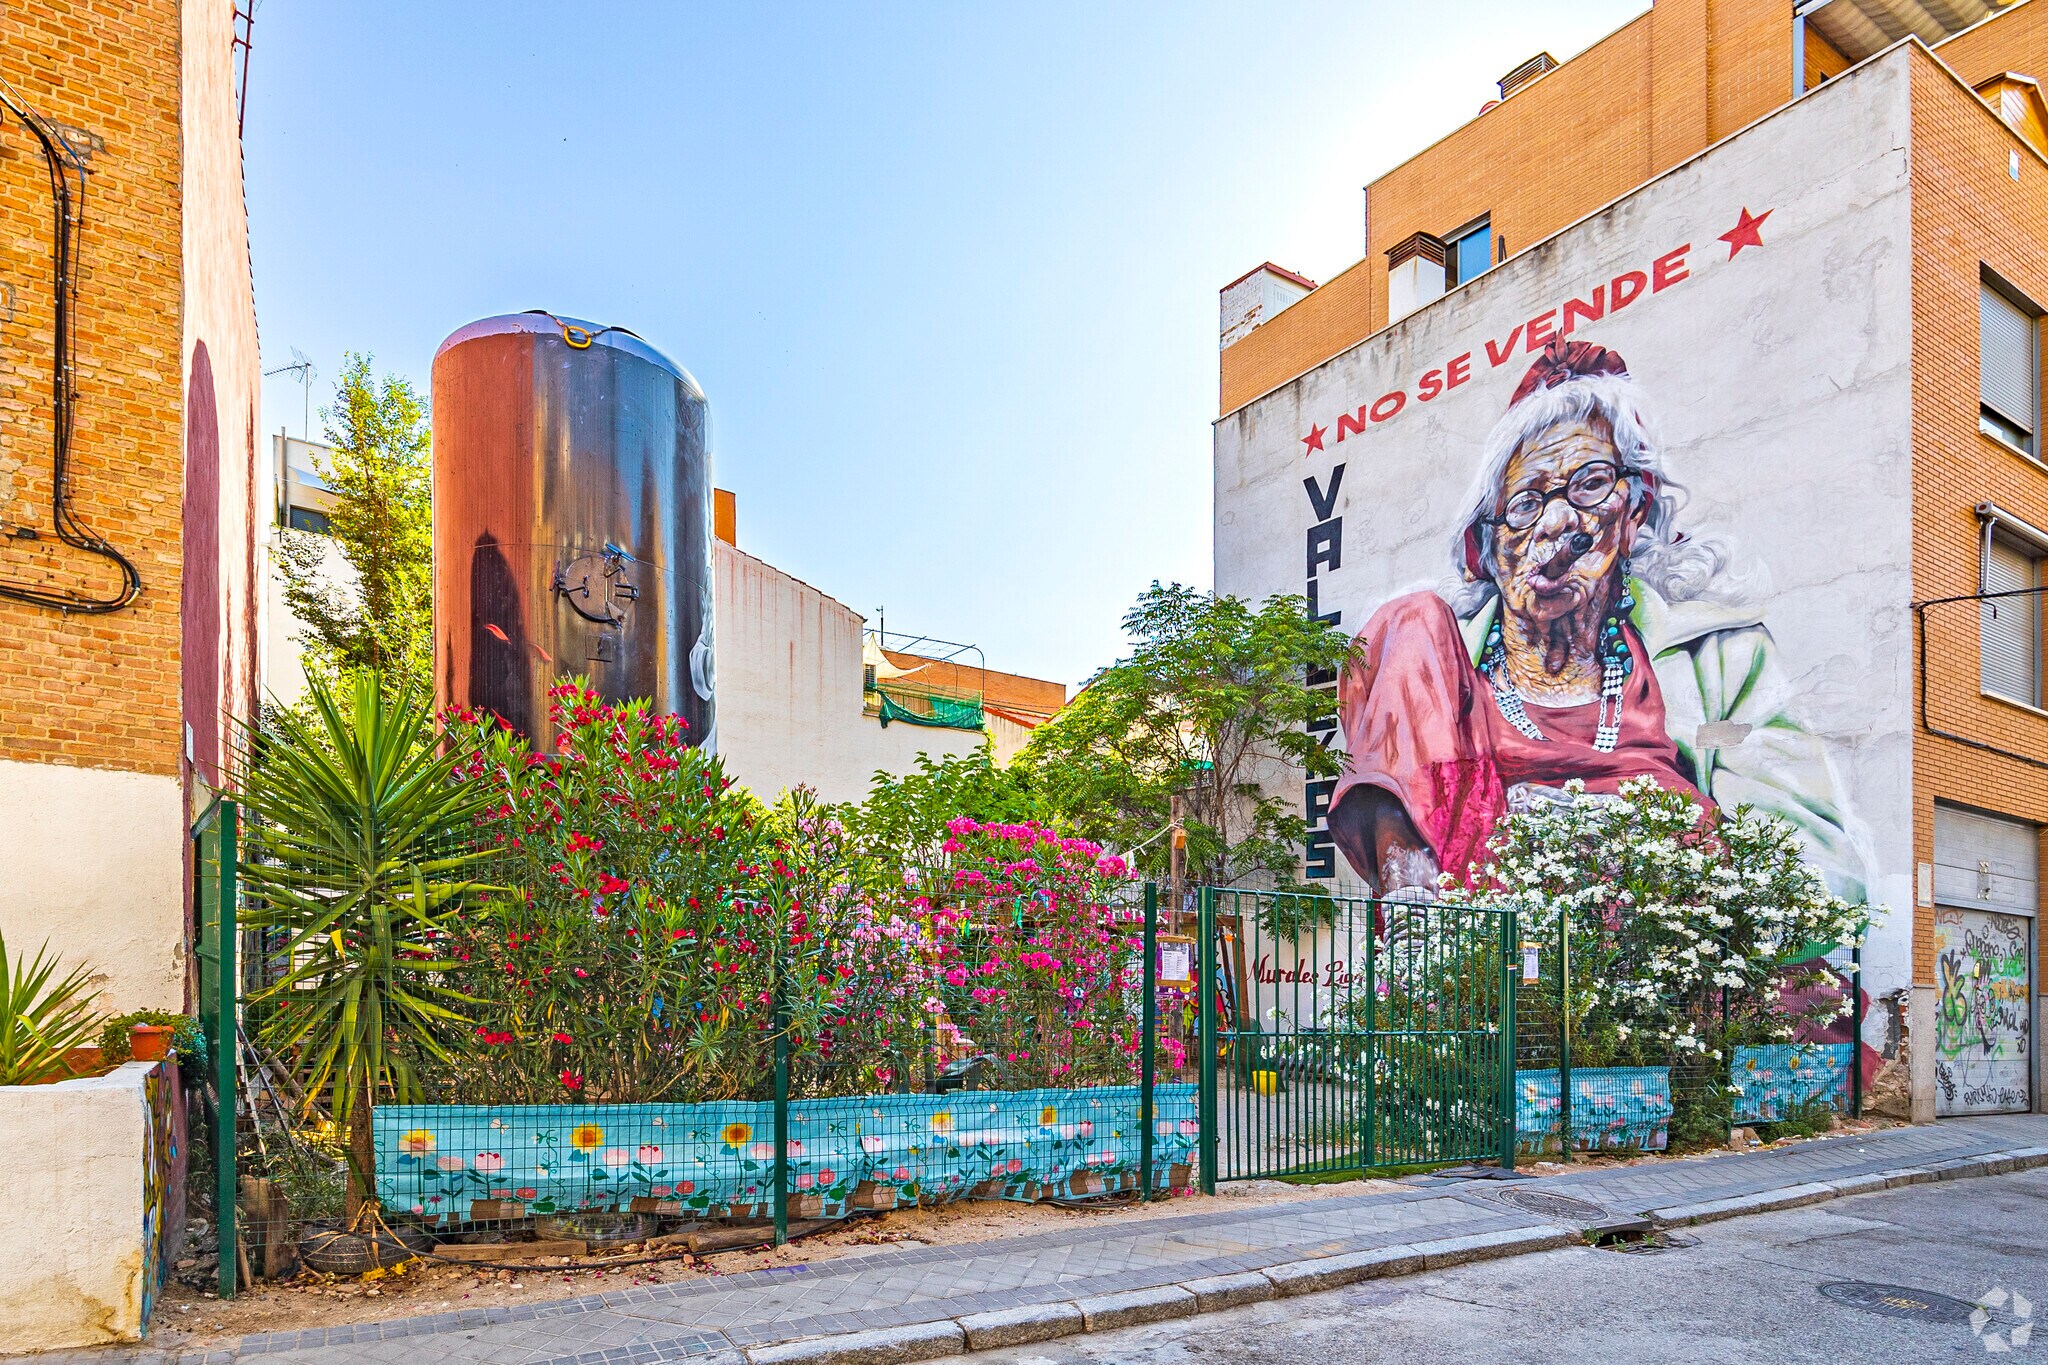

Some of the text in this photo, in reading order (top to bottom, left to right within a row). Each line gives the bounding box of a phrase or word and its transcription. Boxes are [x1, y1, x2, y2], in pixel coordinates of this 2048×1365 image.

[1336, 243, 1691, 443] NO SE VENDE
[1246, 954, 1320, 985] Murales
